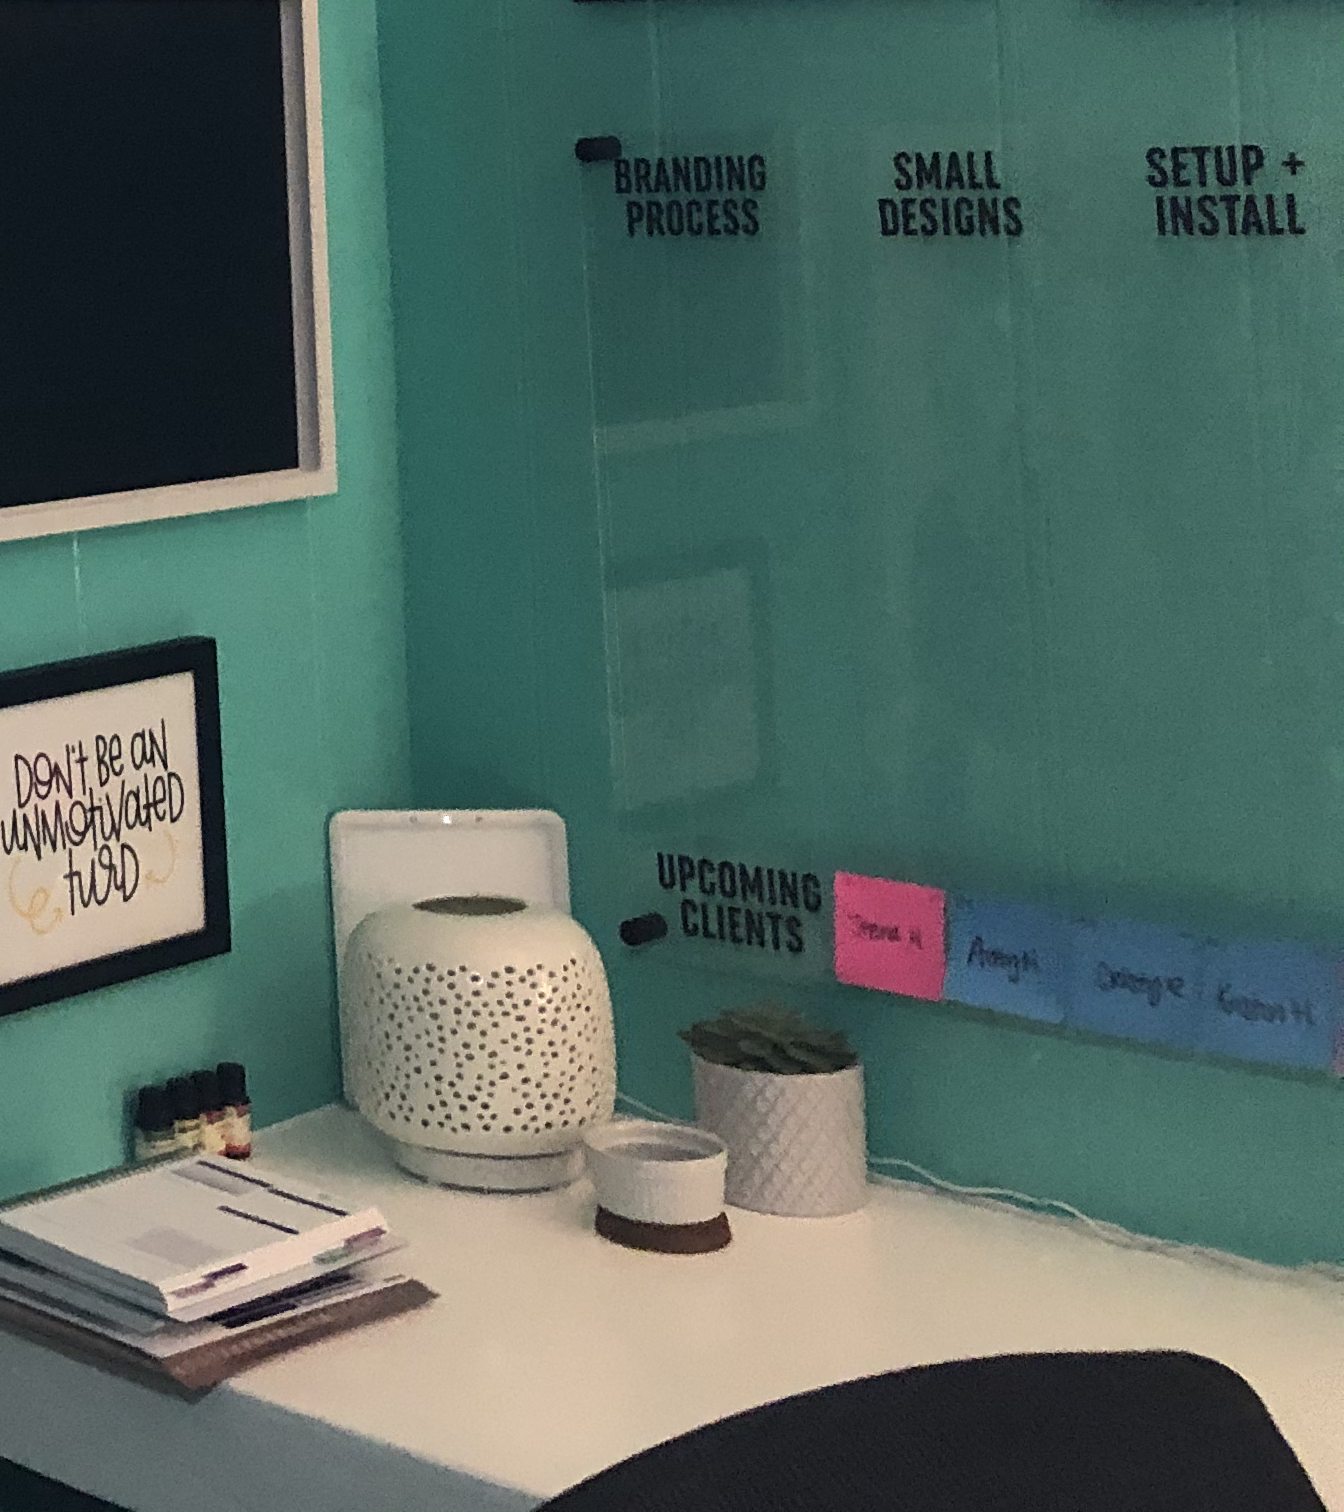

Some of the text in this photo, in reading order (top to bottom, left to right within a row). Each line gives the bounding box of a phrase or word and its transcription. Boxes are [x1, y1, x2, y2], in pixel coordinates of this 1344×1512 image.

[612, 154, 767, 194] BRANDING
[893, 150, 1002, 192] SMALL
[1144, 144, 1306, 189] SETUP +
[625, 198, 761, 237] PROCESS
[878, 197, 1024, 237] DESIGNS
[1155, 192, 1307, 237] INSTALL
[656, 851, 822, 914] UPCOMING
[680, 897, 805, 954] CLIENTS
